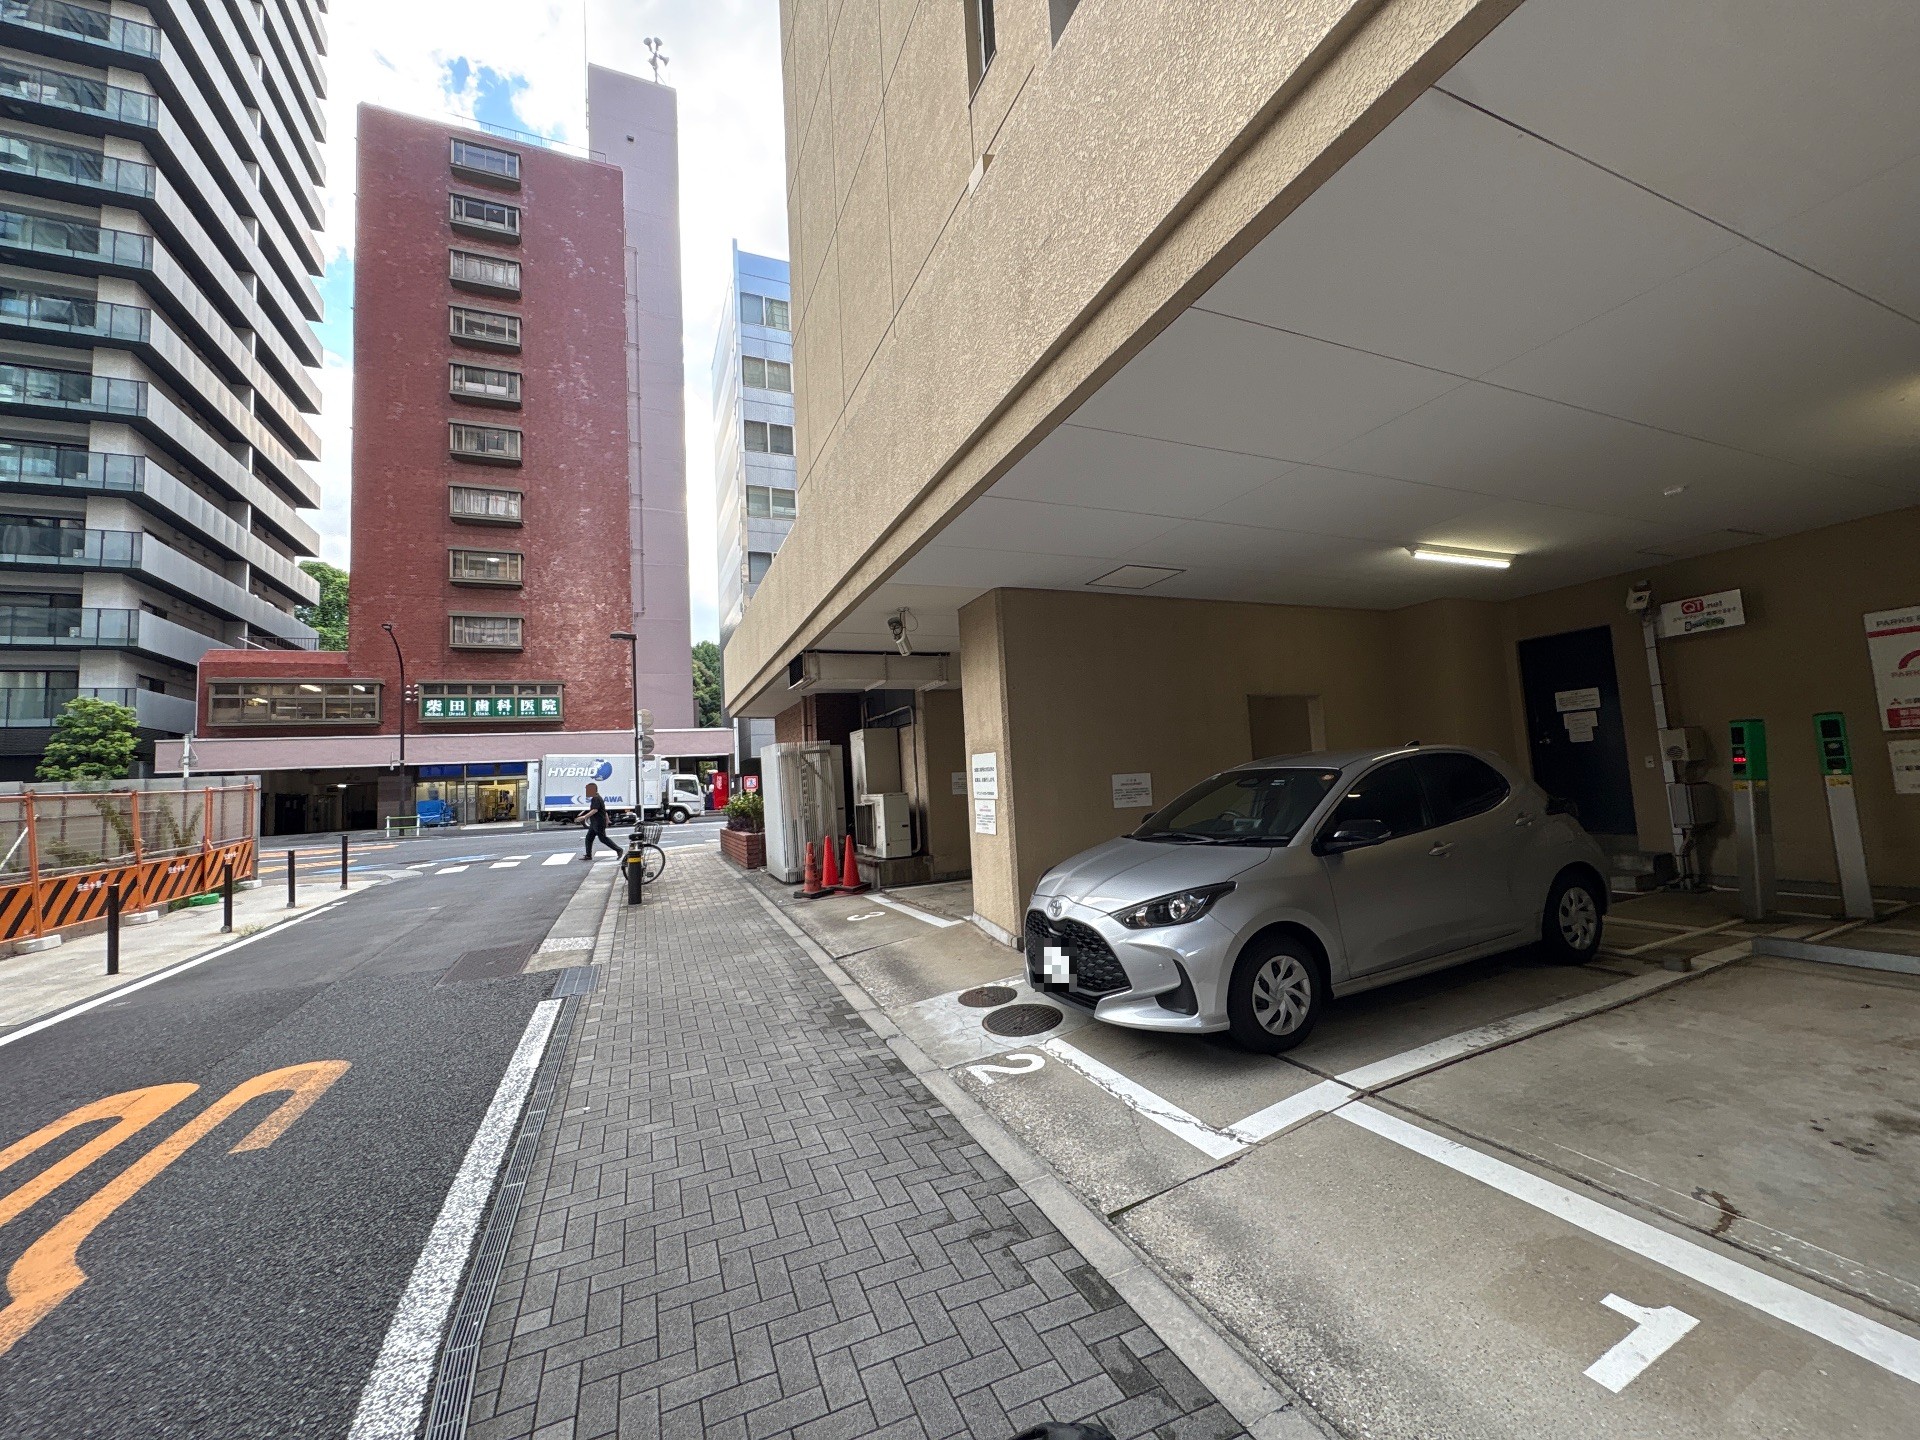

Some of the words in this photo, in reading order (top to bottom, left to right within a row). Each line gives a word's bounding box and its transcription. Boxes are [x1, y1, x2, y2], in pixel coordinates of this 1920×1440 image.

[1876, 616, 1914, 627] PARKS
[426, 699, 557, 712] 柴田歯科医院
[548, 767, 598, 777] HYBRID
[585, 795, 623, 804] SAWA
[846, 911, 886, 921] 3
[966, 1053, 1045, 1085] 2
[1582, 1293, 1700, 1393] 1
